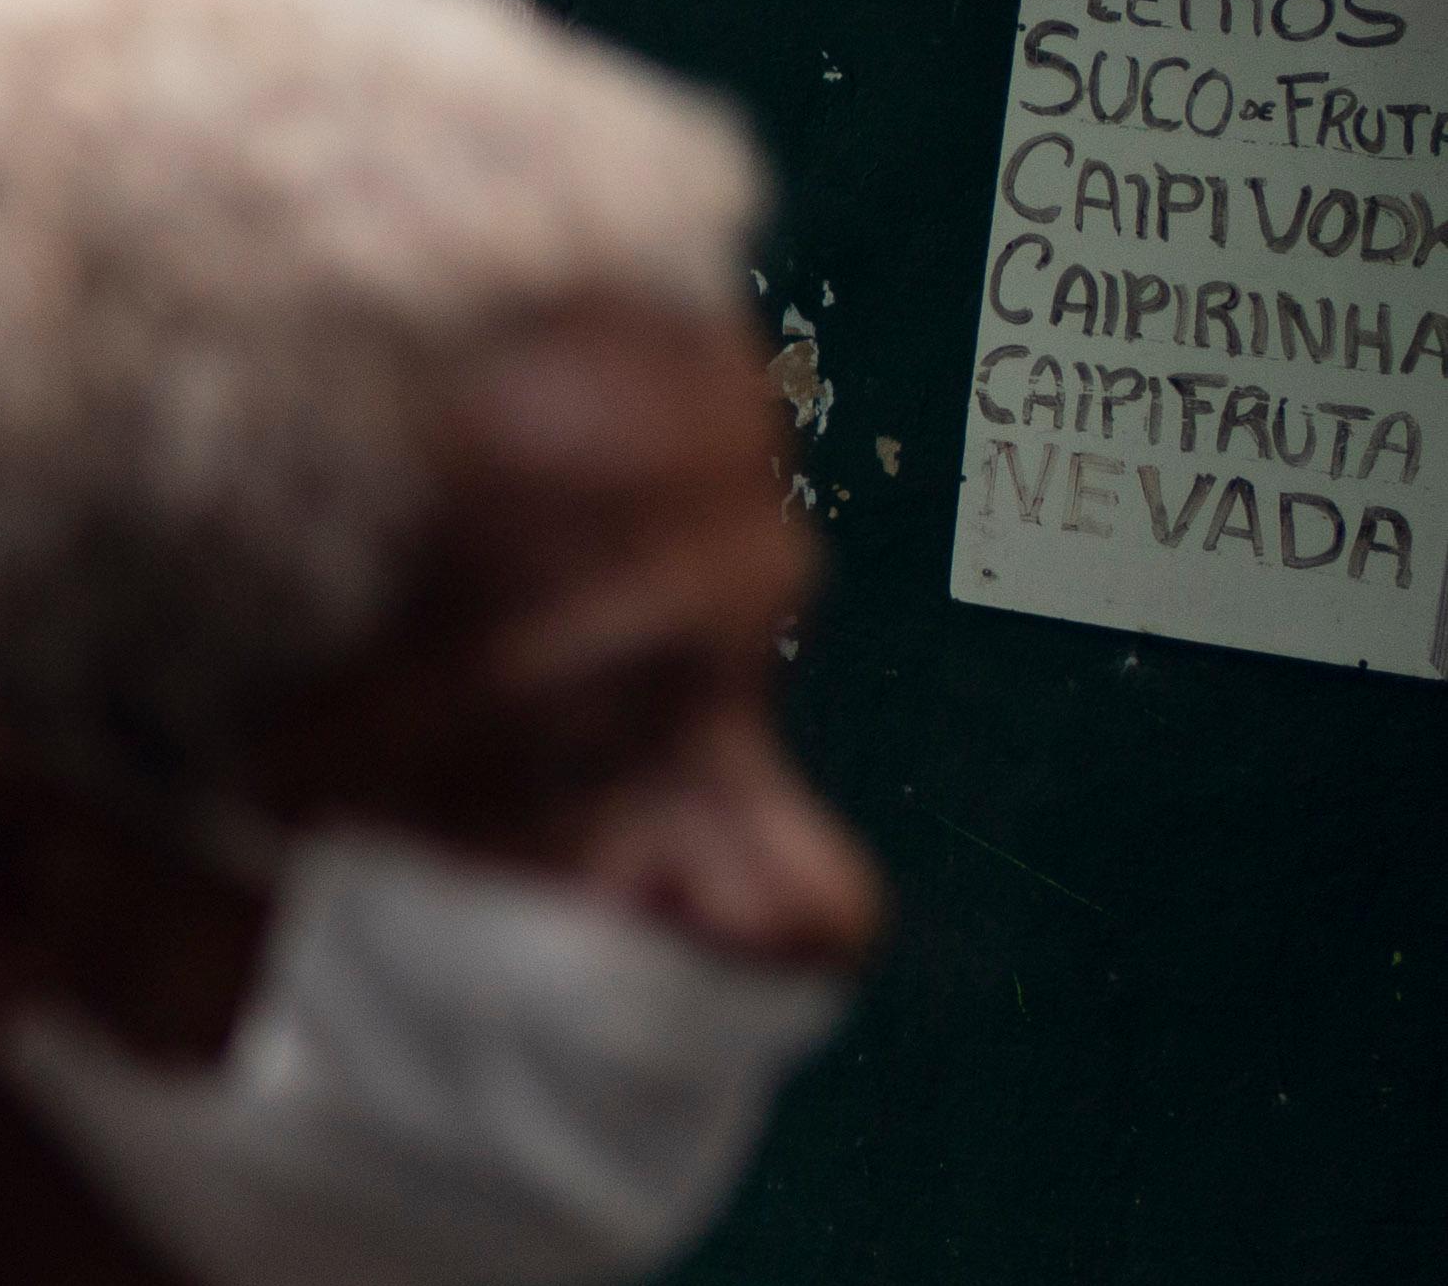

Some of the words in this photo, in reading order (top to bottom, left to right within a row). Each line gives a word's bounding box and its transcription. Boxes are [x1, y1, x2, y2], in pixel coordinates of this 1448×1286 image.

[1020, 19, 1234, 137] SUCO
[1238, 98, 1274, 122] DE
[989, 232, 1448, 378] CAIPIRINHA
[975, 344, 1423, 484] CAIPIFRUTA
[979, 439, 1414, 589] NEVADA
